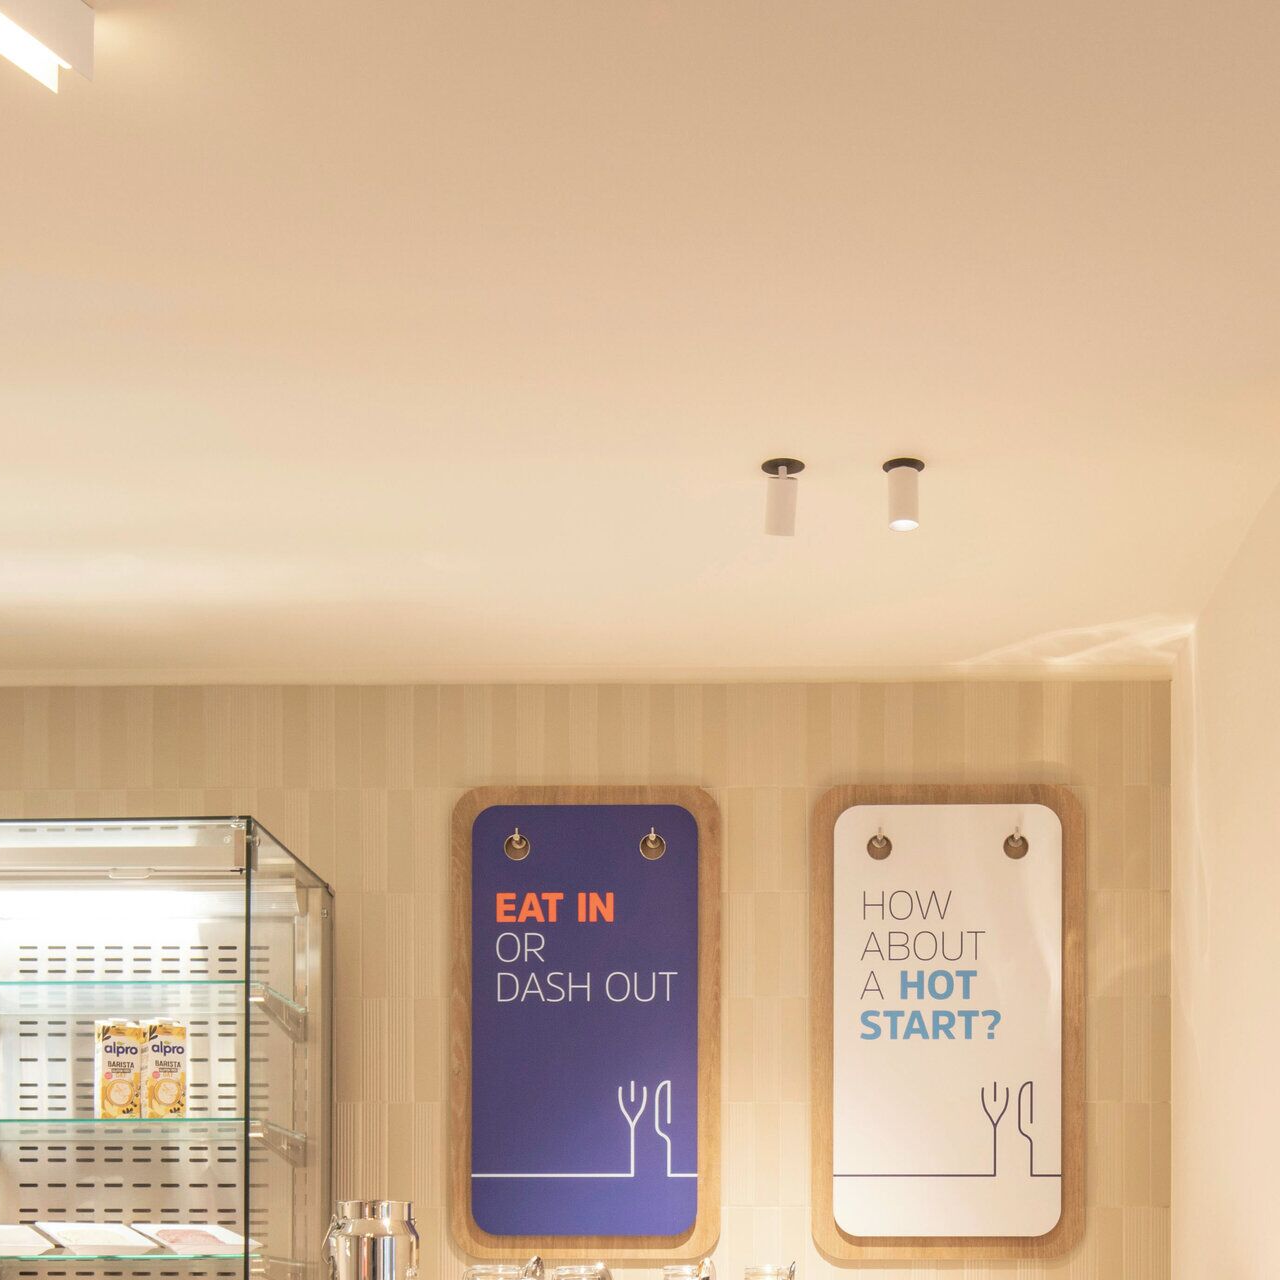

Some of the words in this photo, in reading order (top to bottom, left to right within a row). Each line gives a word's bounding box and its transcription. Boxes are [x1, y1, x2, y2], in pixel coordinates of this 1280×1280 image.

[496, 892, 564, 923] EAT
[577, 892, 614, 923] IN
[863, 890, 952, 920] HOW
[496, 932, 545, 963] OR
[860, 930, 986, 961] ABOUT
[497, 971, 590, 1002] DASH
[605, 971, 678, 1002] OUT
[860, 970, 884, 1000] A
[900, 969, 977, 1000] HOT
[860, 1009, 1002, 1040] START?
[104, 1041, 138, 1057] alpro
[107, 1060, 134, 1069] BARISTA
[151, 1041, 185, 1057] alpro
[155, 1060, 181, 1068] BARISTA
